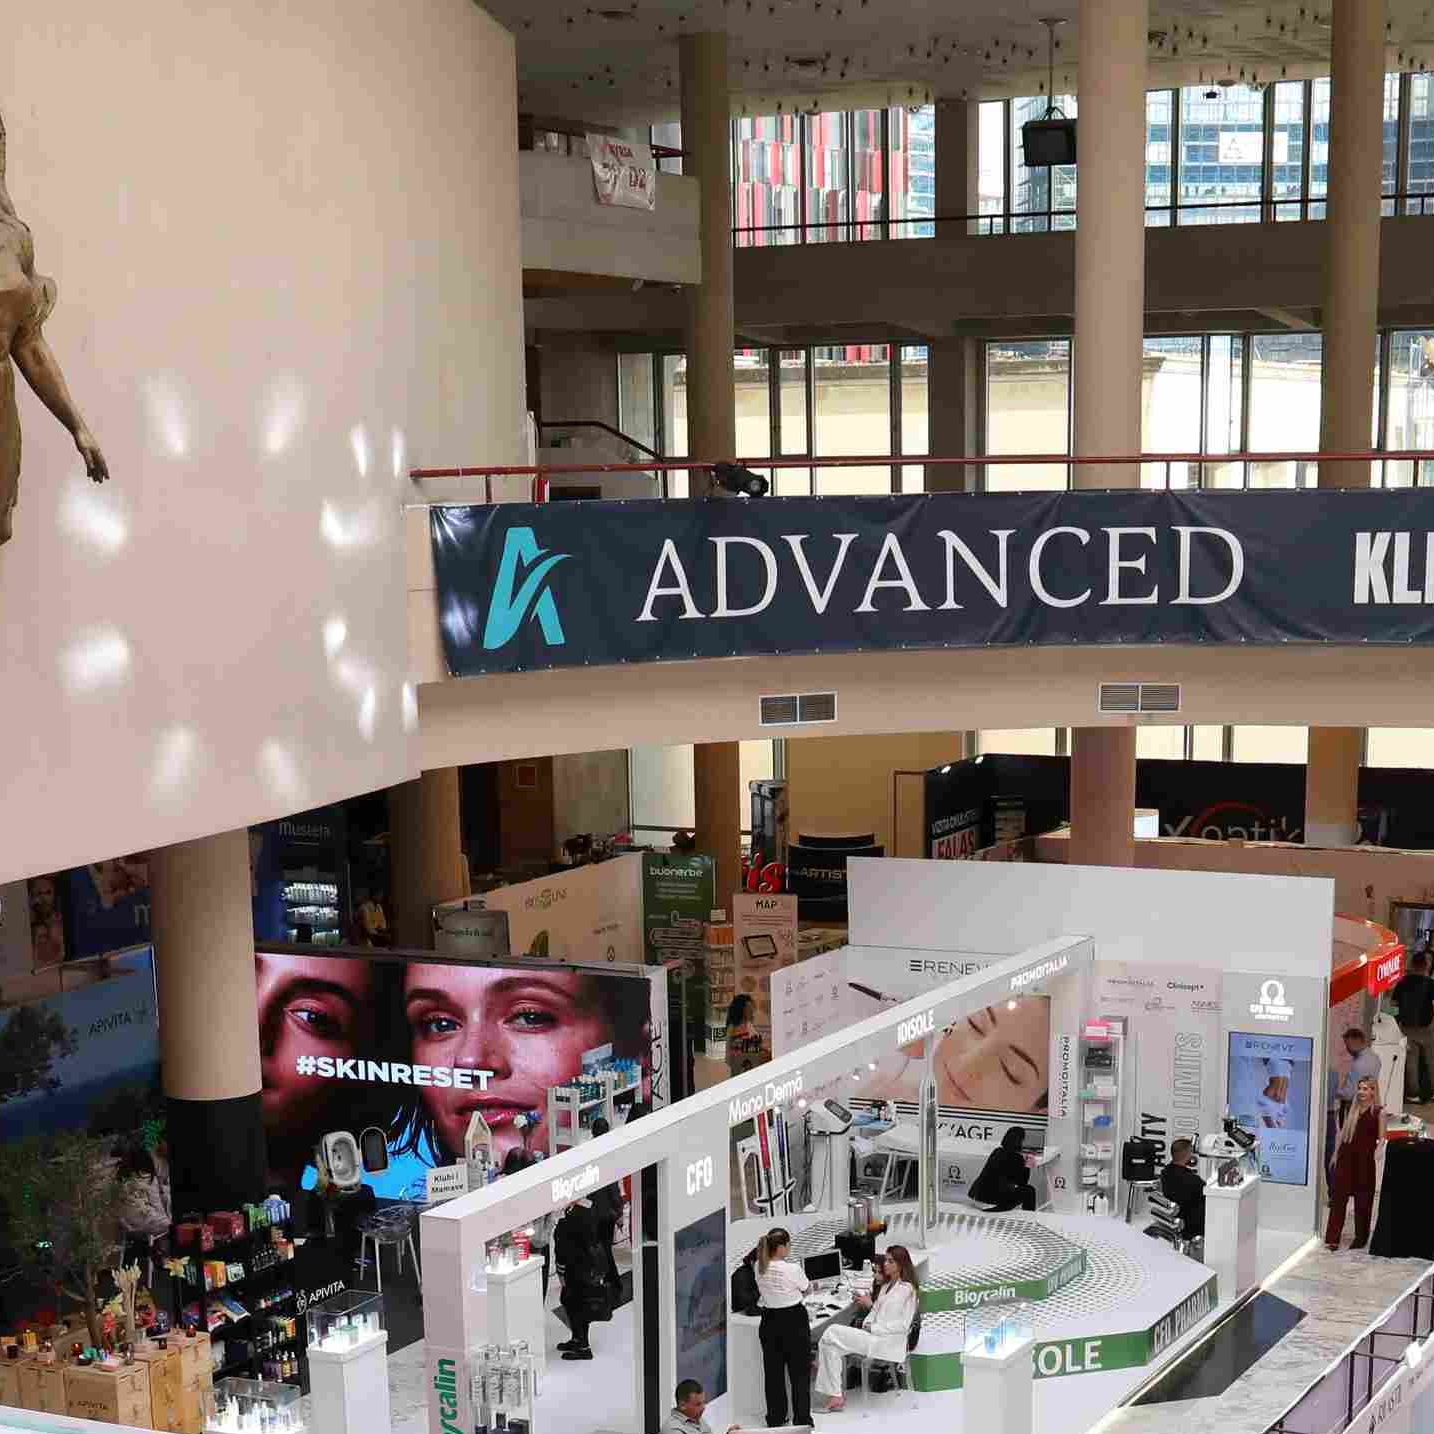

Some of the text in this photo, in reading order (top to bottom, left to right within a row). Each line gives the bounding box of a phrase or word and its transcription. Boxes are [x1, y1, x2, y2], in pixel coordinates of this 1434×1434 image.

[635, 526, 1245, 621] ADVANCED
[924, 960, 991, 975] RENE
[295, 1053, 494, 1092] #SKINRESET
[727, 1091, 763, 1121] Mono
[686, 1155, 713, 1195] CFO
[954, 1283, 1017, 1307] Bioscalin
[1153, 1317, 1172, 1354] CFO
[1031, 1340, 1103, 1377] OLE
